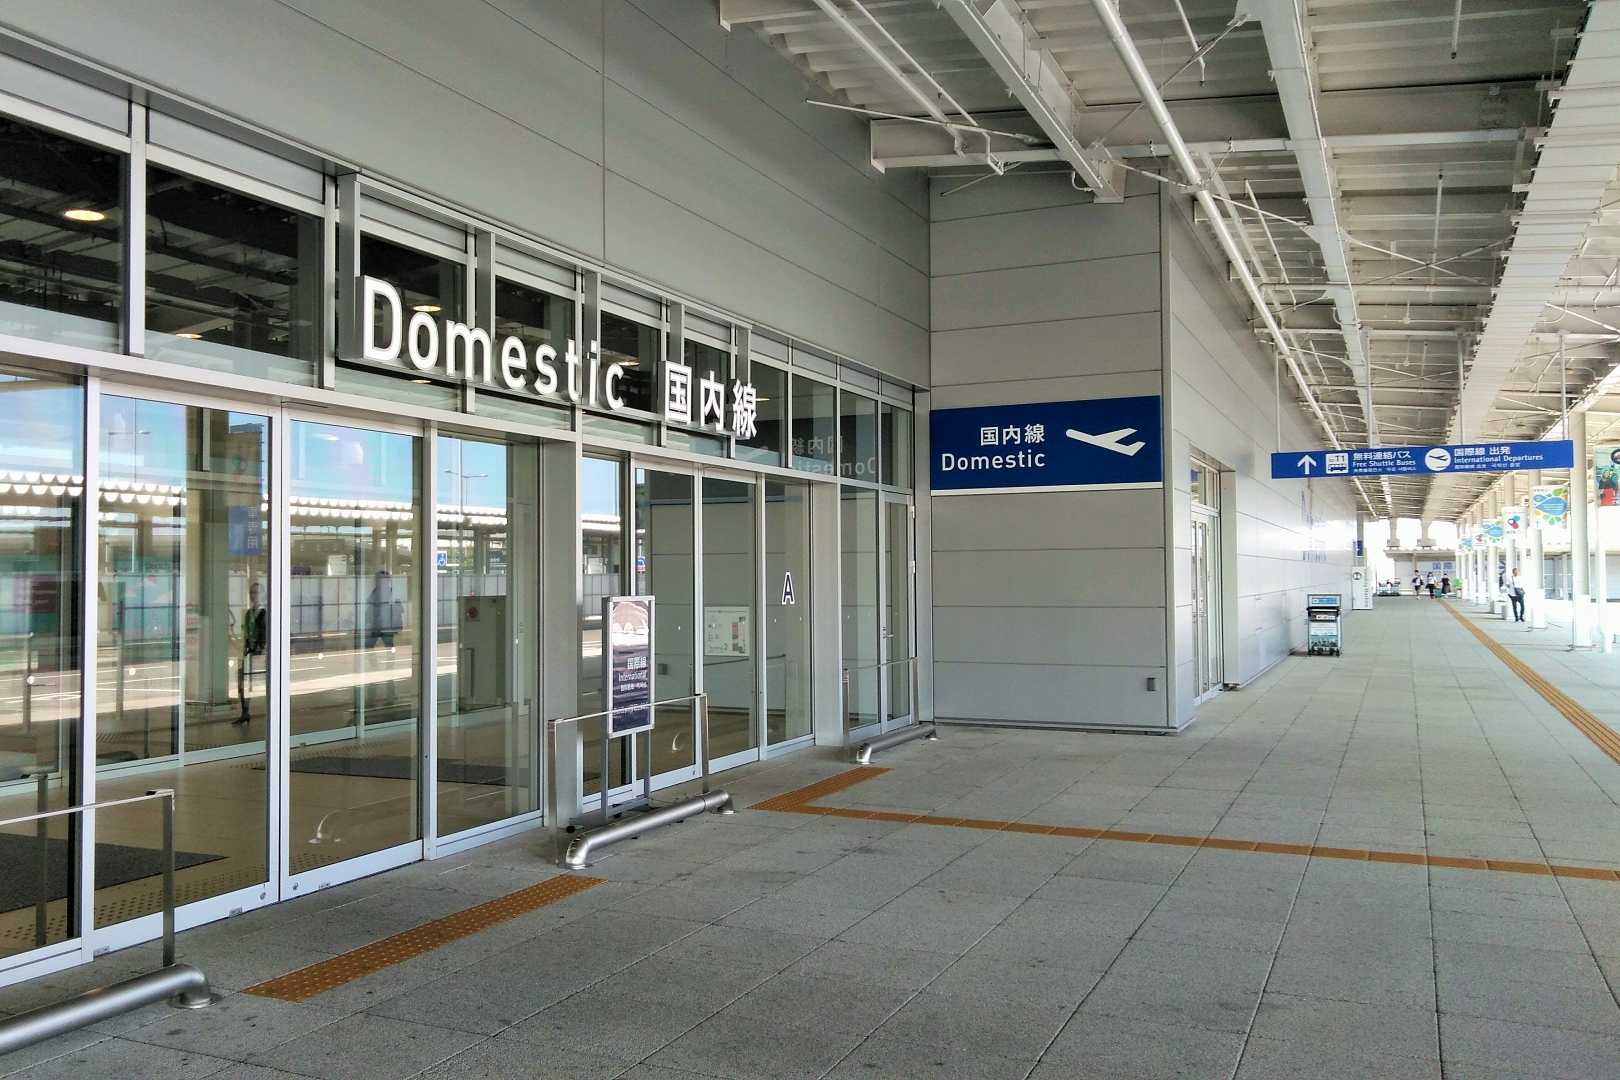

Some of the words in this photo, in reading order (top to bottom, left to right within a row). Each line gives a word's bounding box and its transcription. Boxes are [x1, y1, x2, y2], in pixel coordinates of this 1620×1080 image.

[361, 275, 625, 411] Domestic
[662, 360, 759, 439] 国内線
[980, 424, 1045, 446] 国内線
[941, 449, 1046, 471] Domestic
[1454, 447, 1486, 456] 国際線
[1489, 446, 1511, 455] 出発
[1454, 455, 1501, 463] International
[1503, 454, 1544, 462] Departures
[781, 571, 795, 605] A
[618, 670, 648, 682] International
